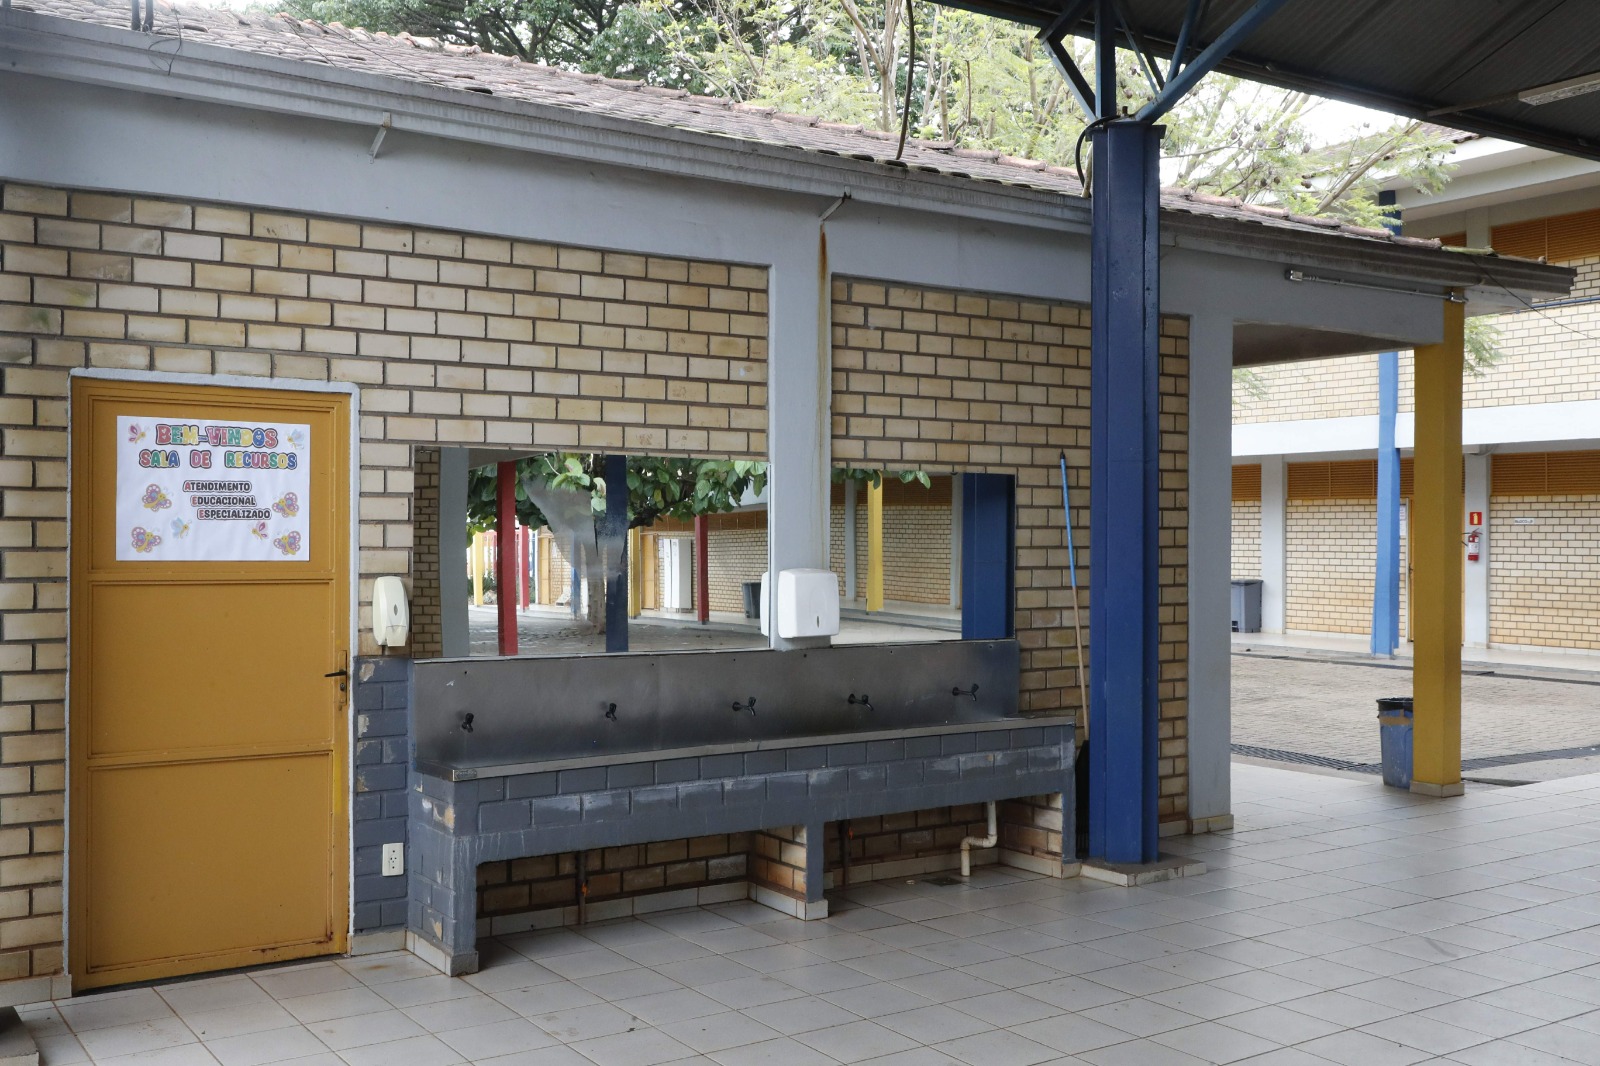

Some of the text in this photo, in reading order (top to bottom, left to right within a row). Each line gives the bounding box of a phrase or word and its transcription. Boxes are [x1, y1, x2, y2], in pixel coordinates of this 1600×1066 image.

[156, 424, 278, 448] BEM-VINDOS
[139, 449, 297, 469] SALA DE RECURSOS
[184, 481, 251, 492] ATENDIMENTO
[191, 495, 256, 506] EDUCACIONAL
[198, 509, 271, 519] ESPECIALIZADO
